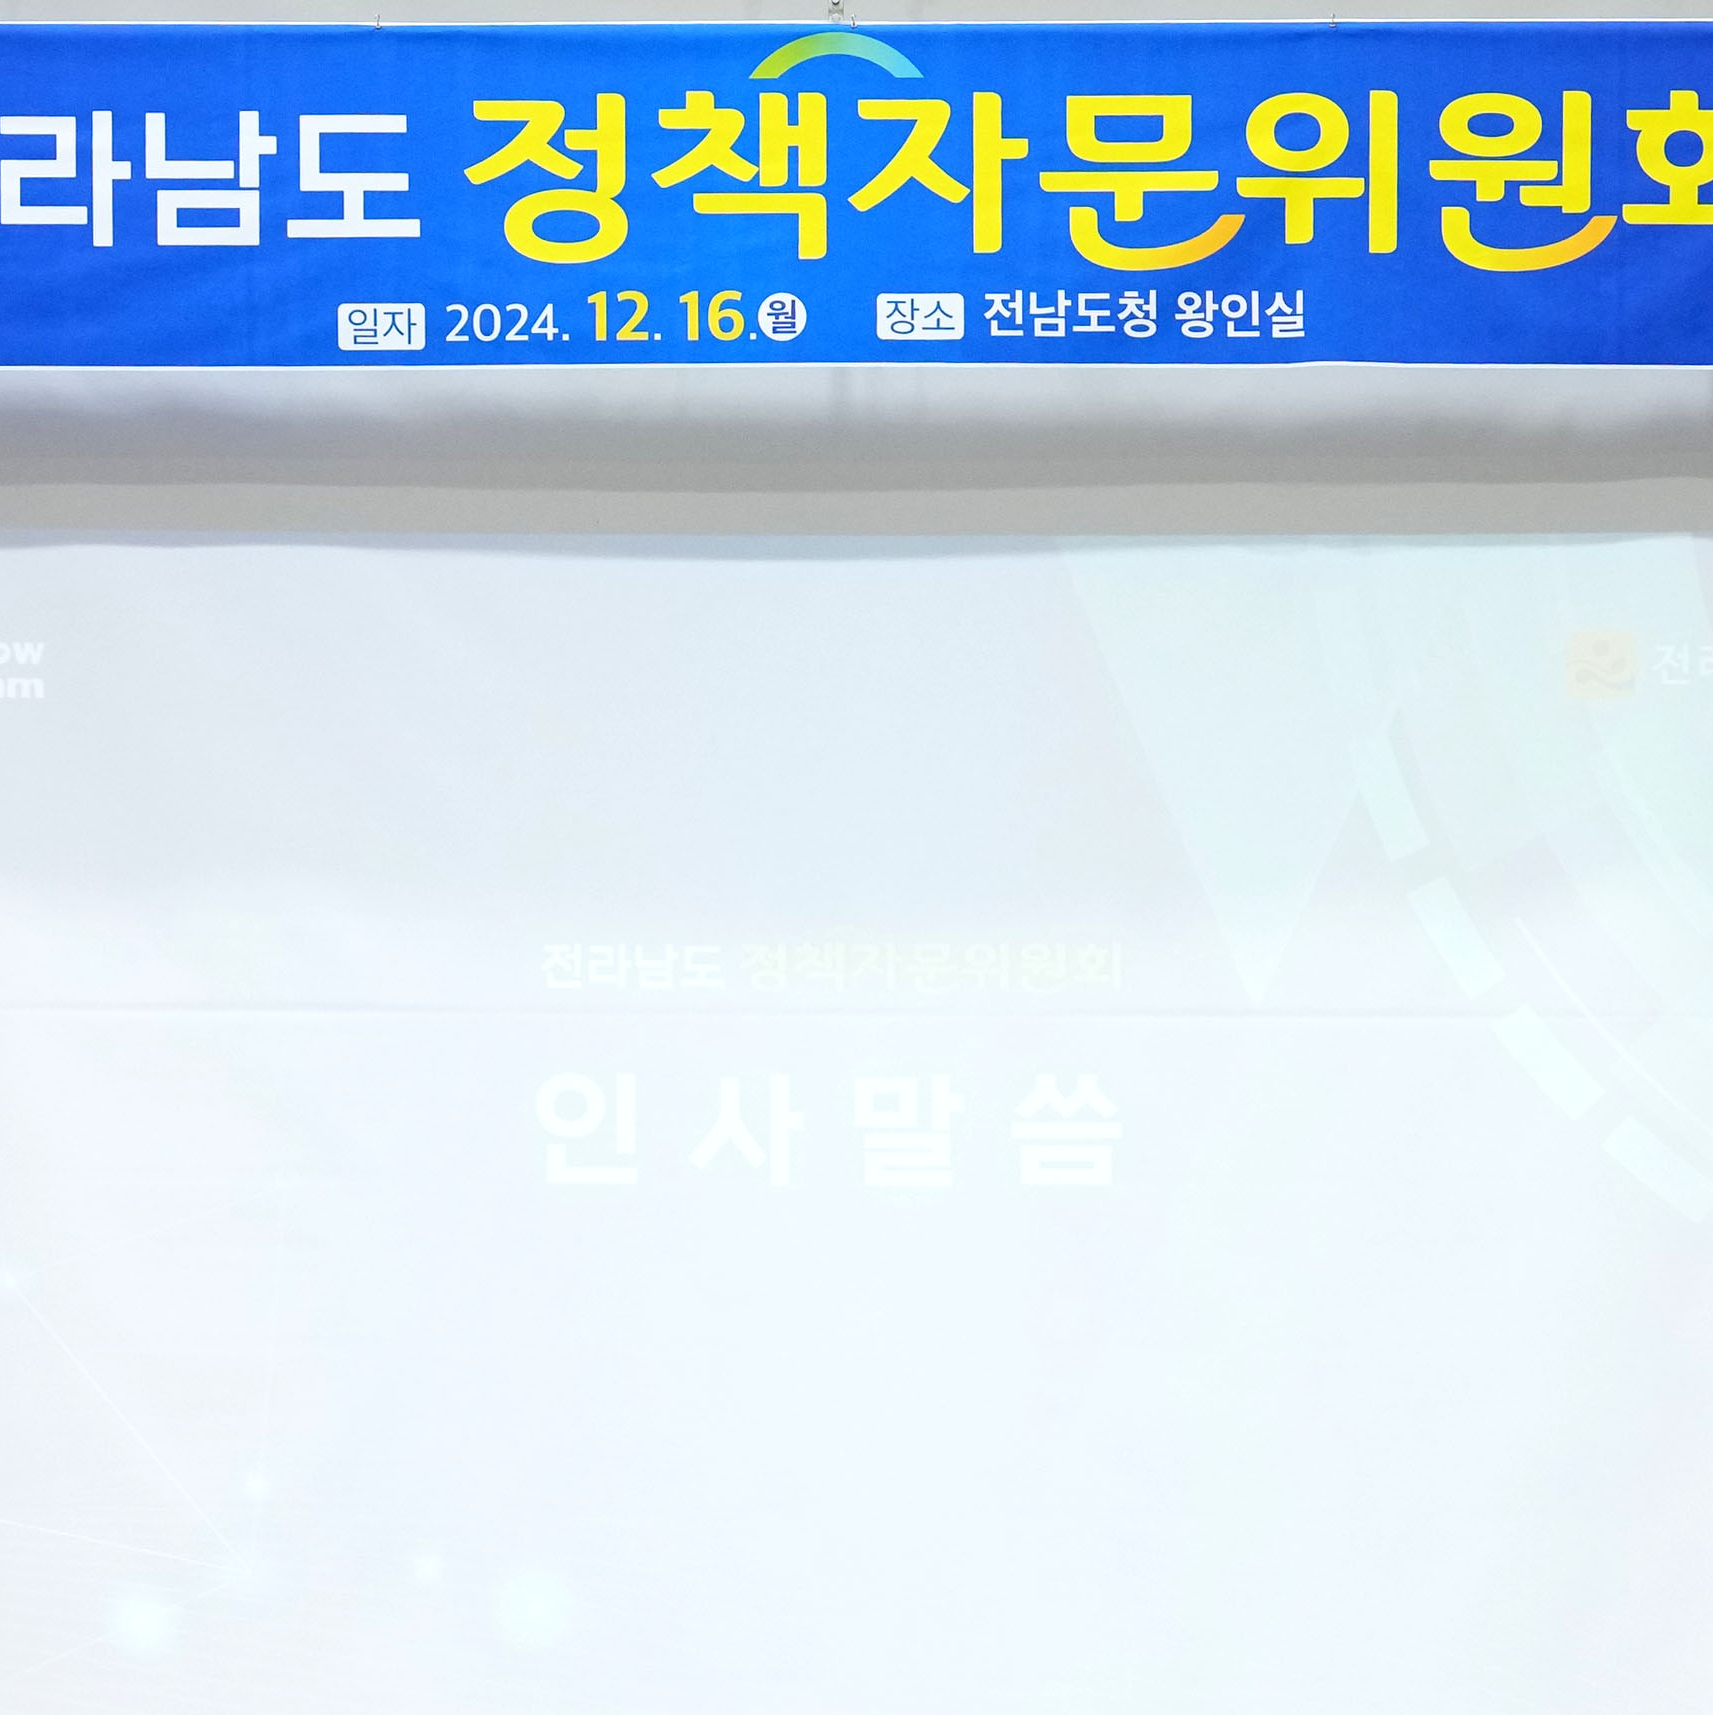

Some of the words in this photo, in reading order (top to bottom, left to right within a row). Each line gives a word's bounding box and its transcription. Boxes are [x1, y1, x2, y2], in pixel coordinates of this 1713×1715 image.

[347, 308, 418, 345] 일자
[445, 303, 570, 342] 2024.
[587, 290, 662, 341] 12.
[885, 297, 957, 335] 장소
[983, 289, 1157, 338] 전남도청
[1174, 289, 1305, 339] 왕인실
[542, 942, 726, 991] 전라남도
[741, 940, 1124, 993] 정책자문위원회
